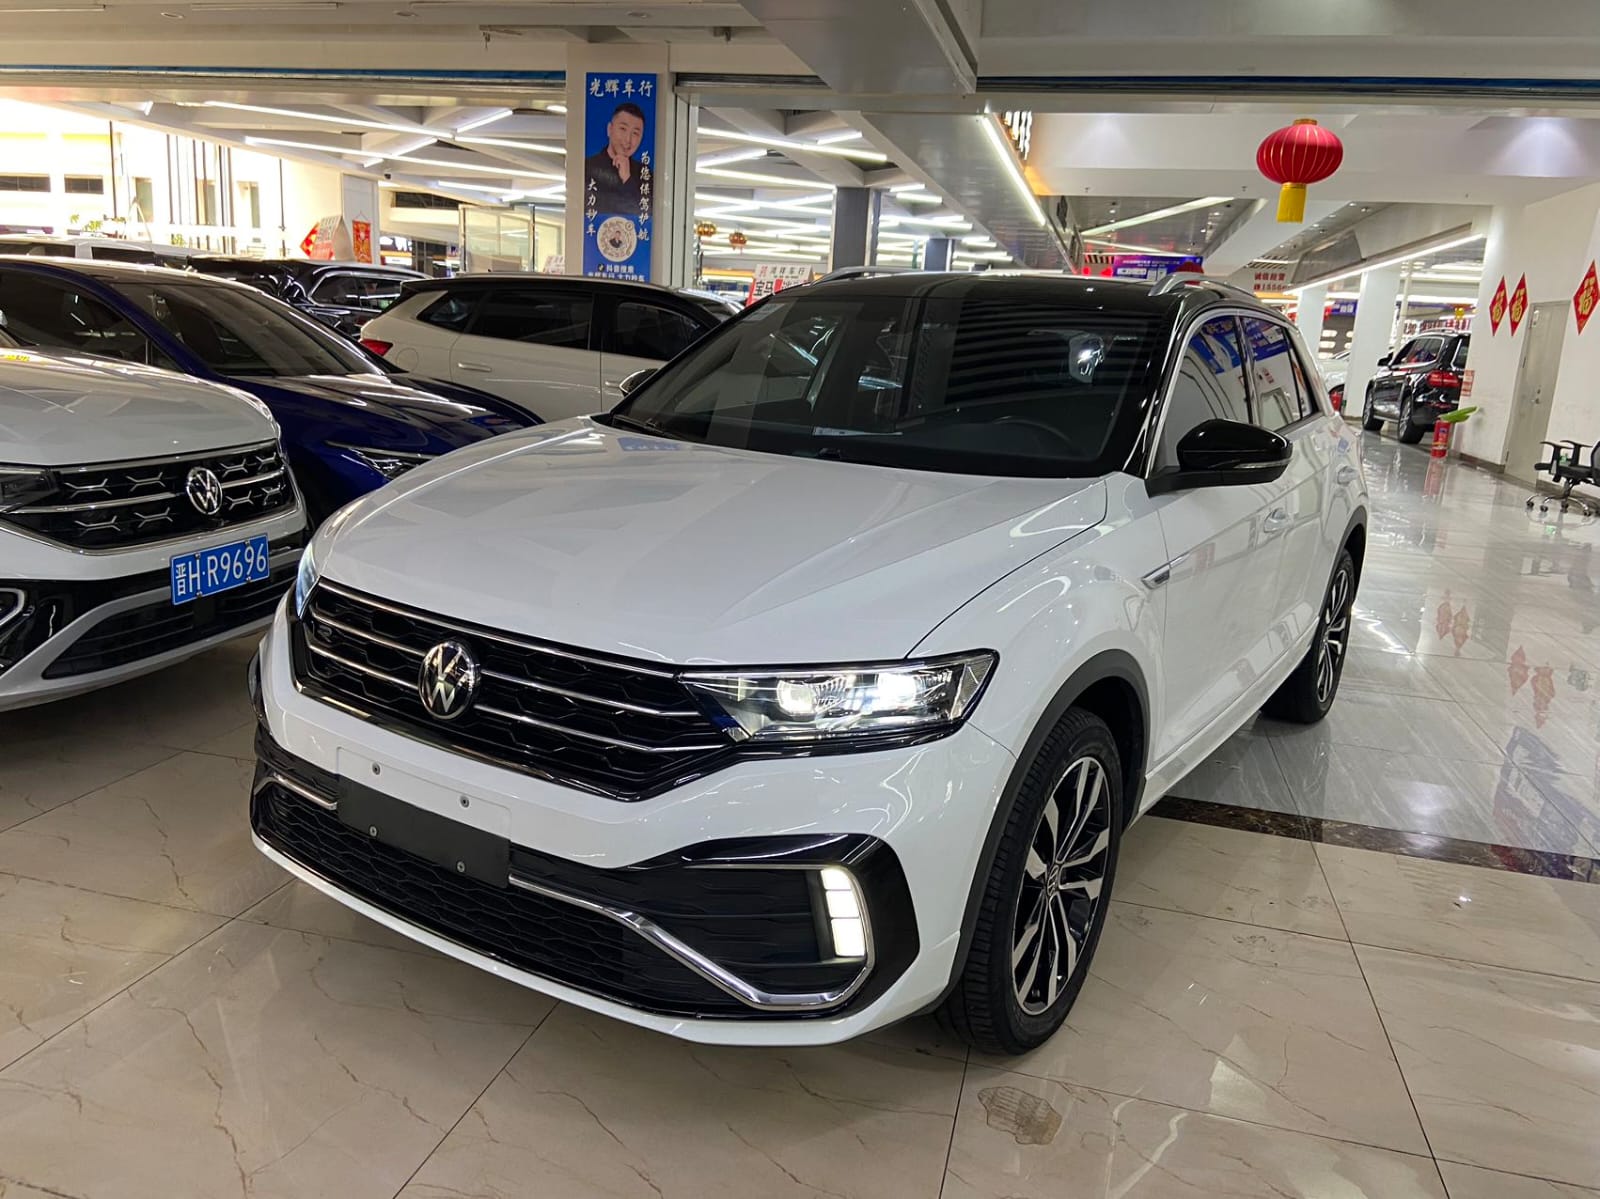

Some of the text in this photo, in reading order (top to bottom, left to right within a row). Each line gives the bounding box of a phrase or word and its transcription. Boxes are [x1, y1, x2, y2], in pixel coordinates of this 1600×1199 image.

[589, 78, 653, 98] 光辉车行
[637, 150, 651, 241] 为您保驾护航
